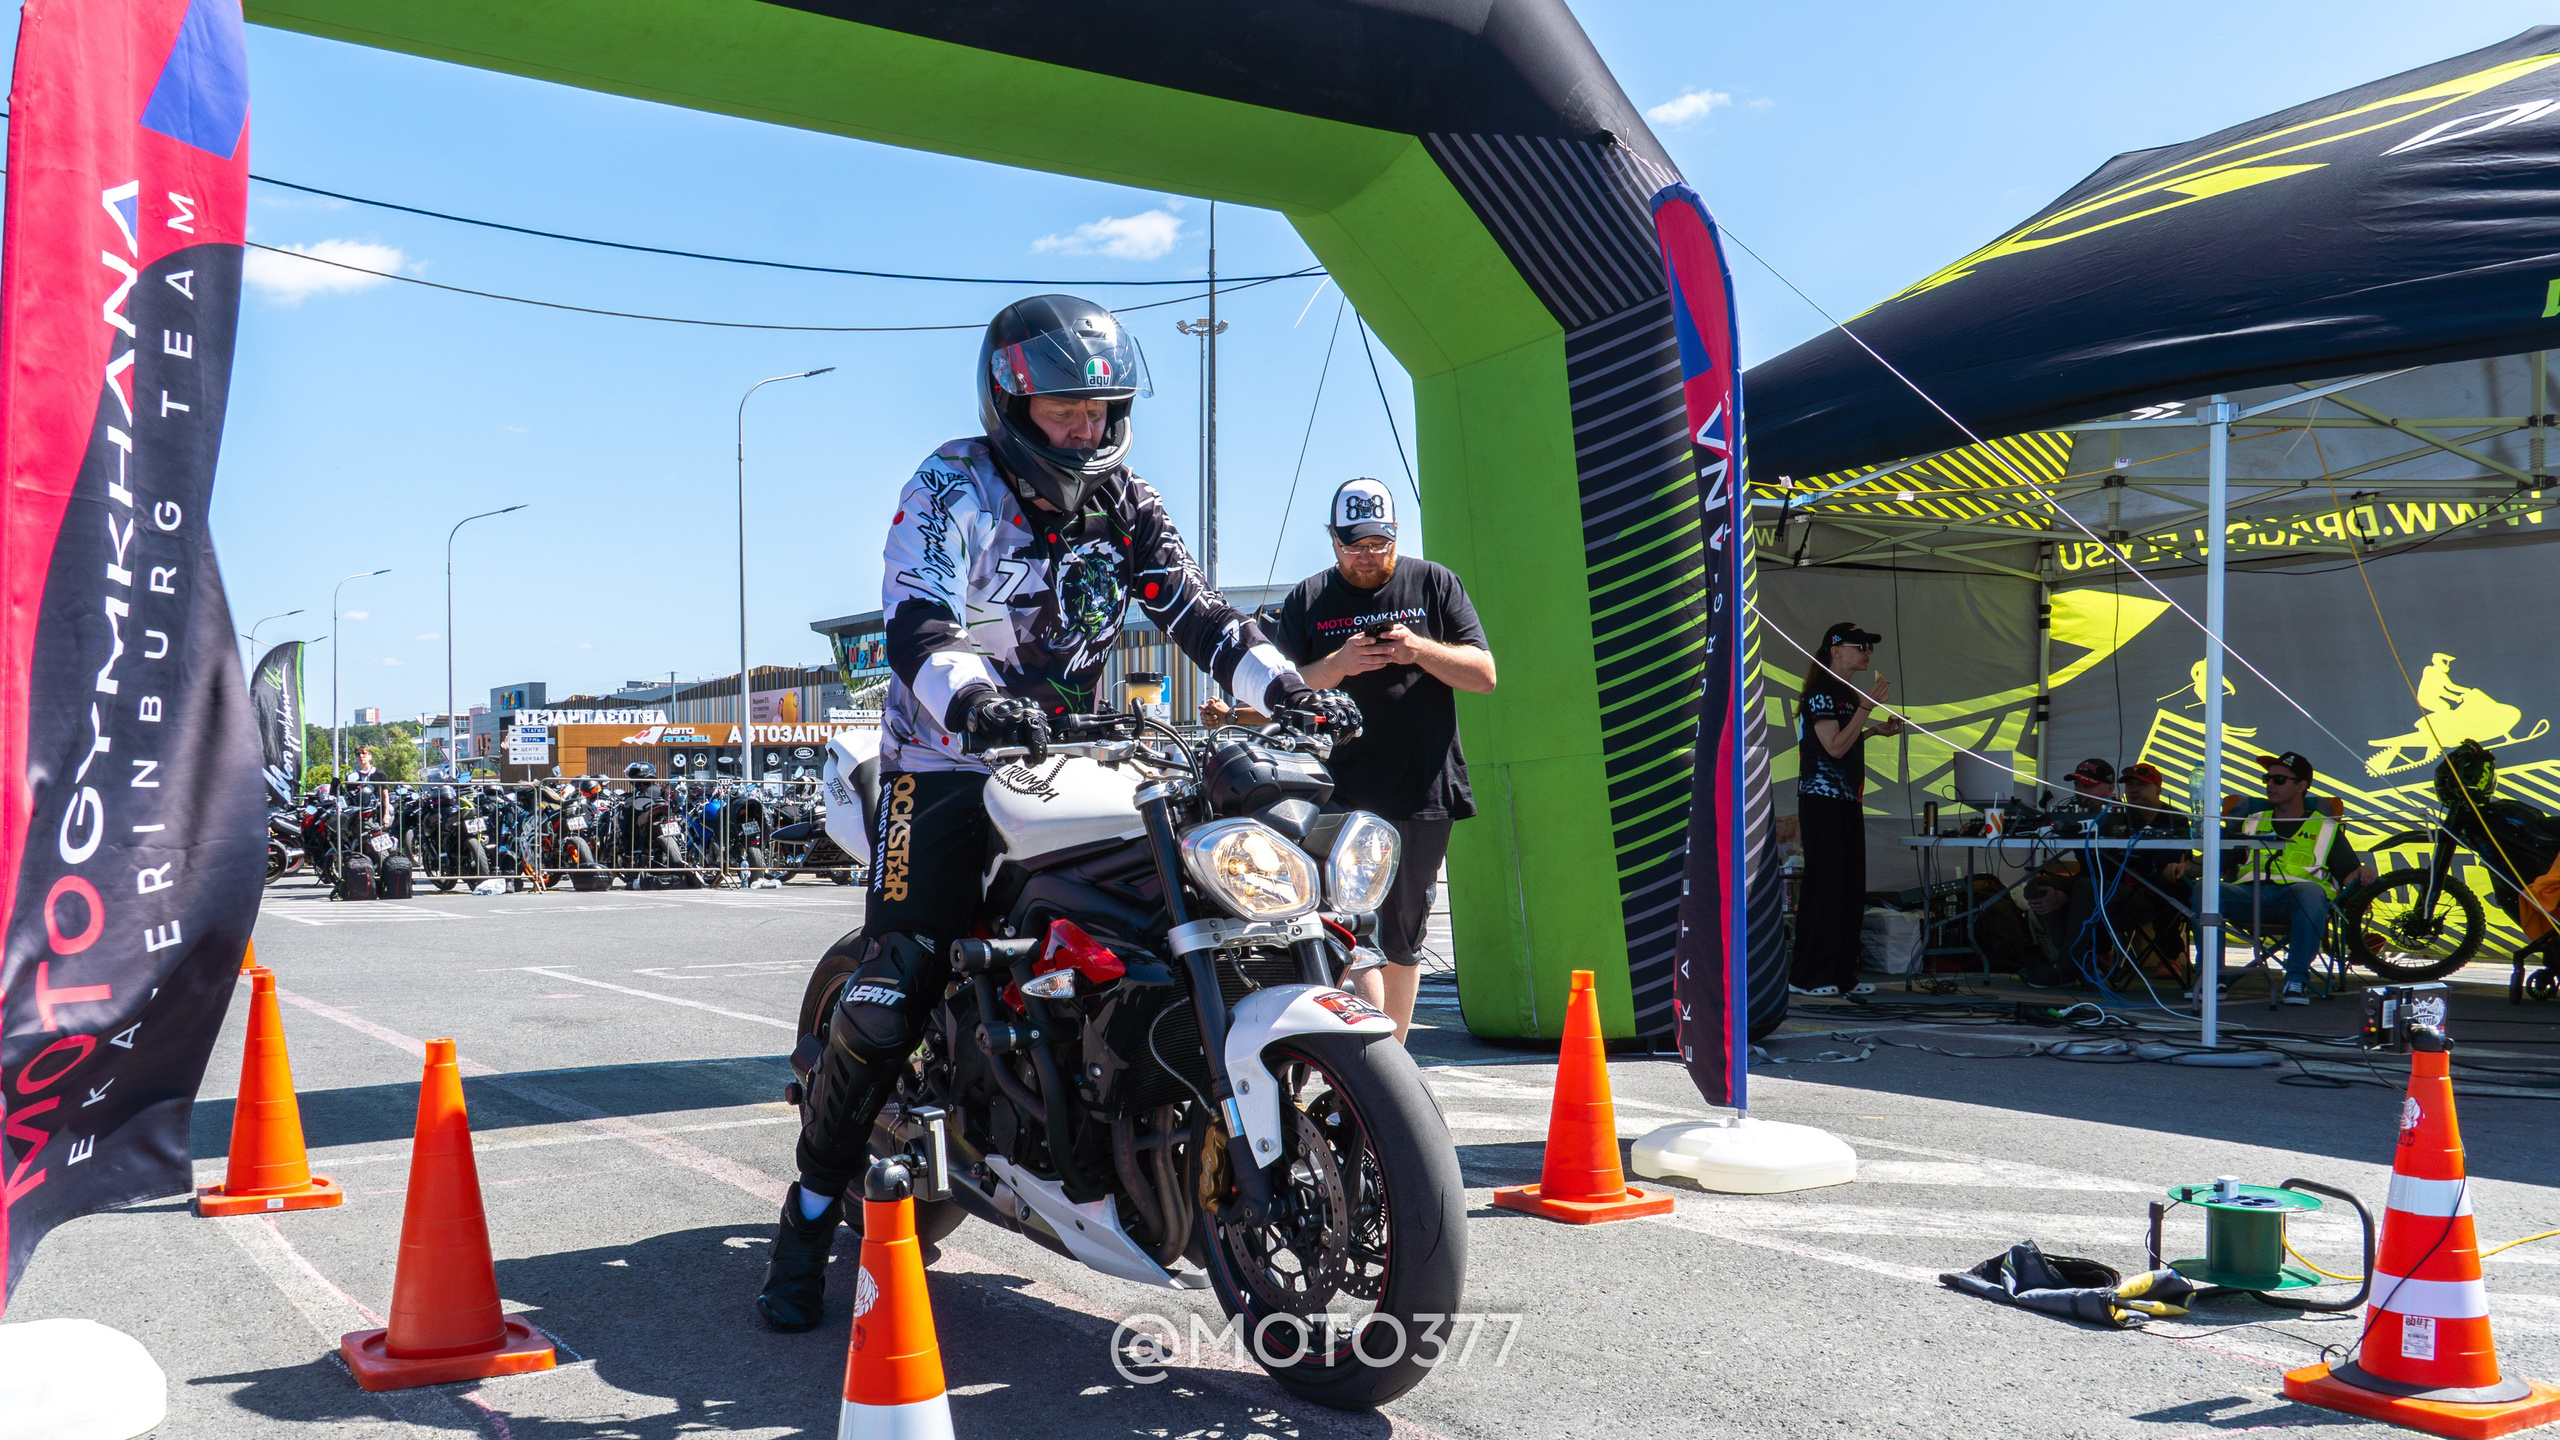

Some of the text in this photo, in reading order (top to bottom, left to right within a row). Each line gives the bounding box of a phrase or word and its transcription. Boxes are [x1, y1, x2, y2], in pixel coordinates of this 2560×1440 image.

[1089, 375, 1110, 387] agv
[987, 558, 1031, 605] 7
[1317, 607, 1427, 631] MOTOGYMKHANA
[1325, 627, 1362, 637] EKATERI
[67, 192, 196, 1167] EKAERINBURG TEAM
[3, 180, 140, 1206] MOTOGYMKHANA
[1808, 694, 1835, 713] 333
[662, 735, 711, 743] ЯПОНЕЦ
[664, 727, 695, 735] АВТО
[873, 781, 892, 893] ENERGY DRINK
[884, 773, 916, 902] OCKSTAR
[846, 985, 907, 1006] LEATT
